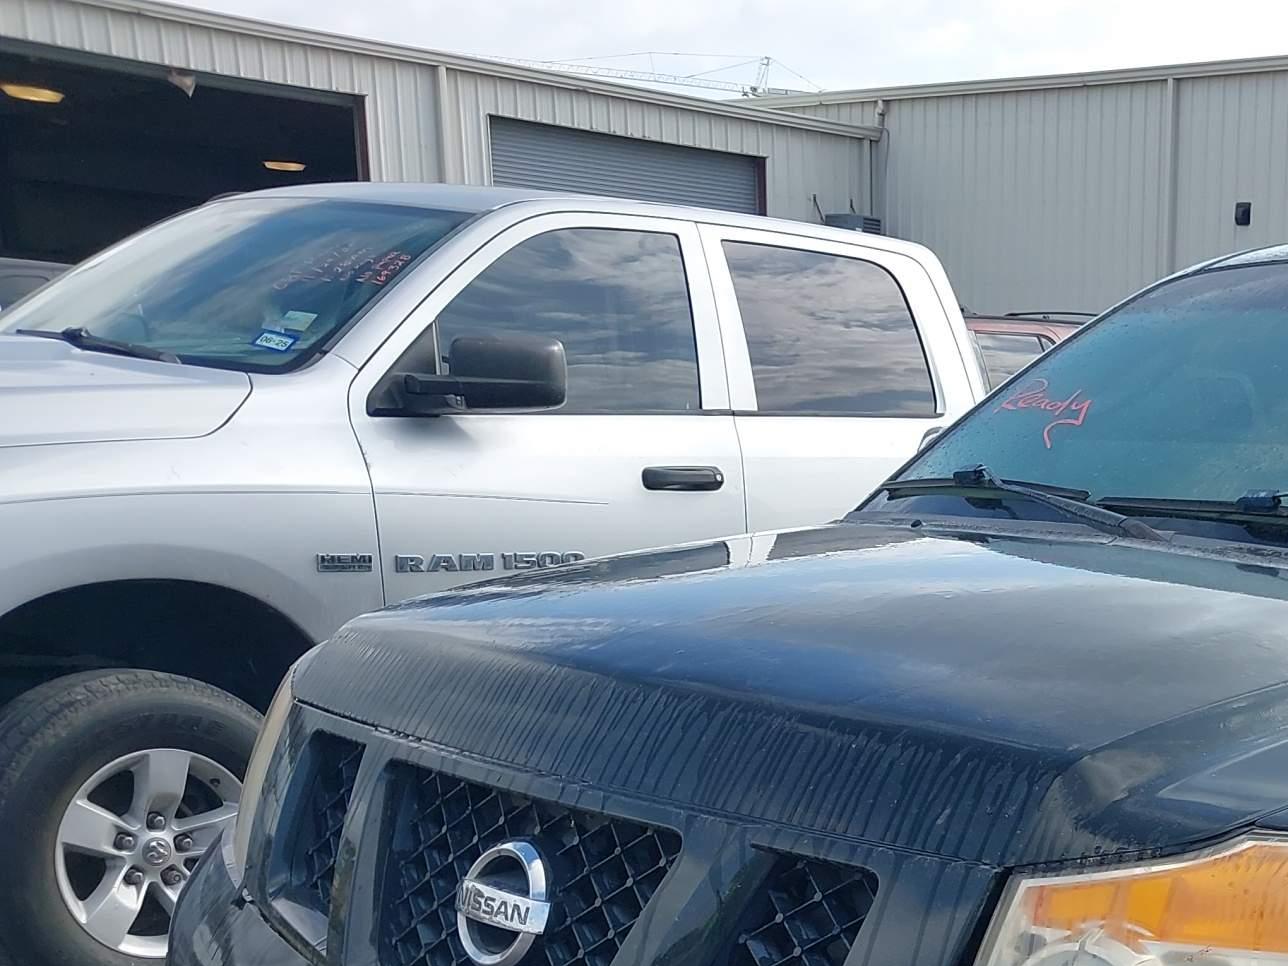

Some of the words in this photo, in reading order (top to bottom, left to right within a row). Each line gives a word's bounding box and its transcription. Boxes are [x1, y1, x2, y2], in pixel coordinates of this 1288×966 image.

[992, 378, 1092, 449] Ready
[319, 554, 373, 564] HEMI
[395, 553, 495, 573] RAM
[456, 884, 530, 926] NISSAN
